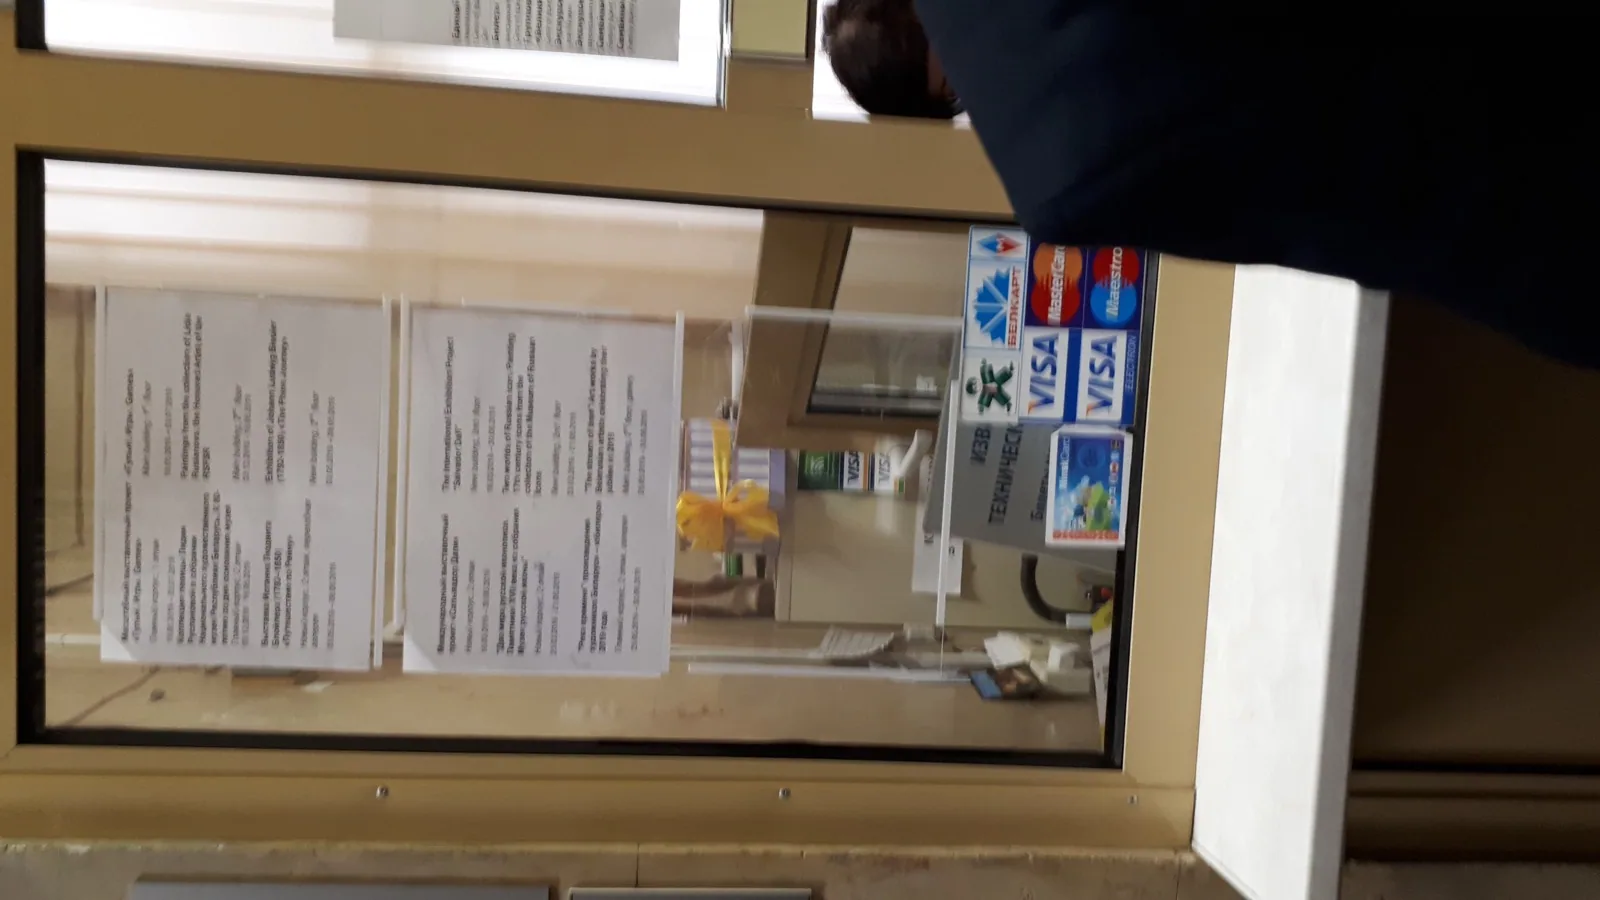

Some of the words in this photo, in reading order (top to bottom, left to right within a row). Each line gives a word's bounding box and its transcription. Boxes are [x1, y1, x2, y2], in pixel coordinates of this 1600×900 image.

[1007, 266, 1022, 347] БЕЛКАРТ
[1105, 246, 1123, 318] Maestro
[1028, 332, 1059, 414] VISA
[1086, 336, 1118, 416] VISA
[1124, 334, 1137, 391] ELECTRON
